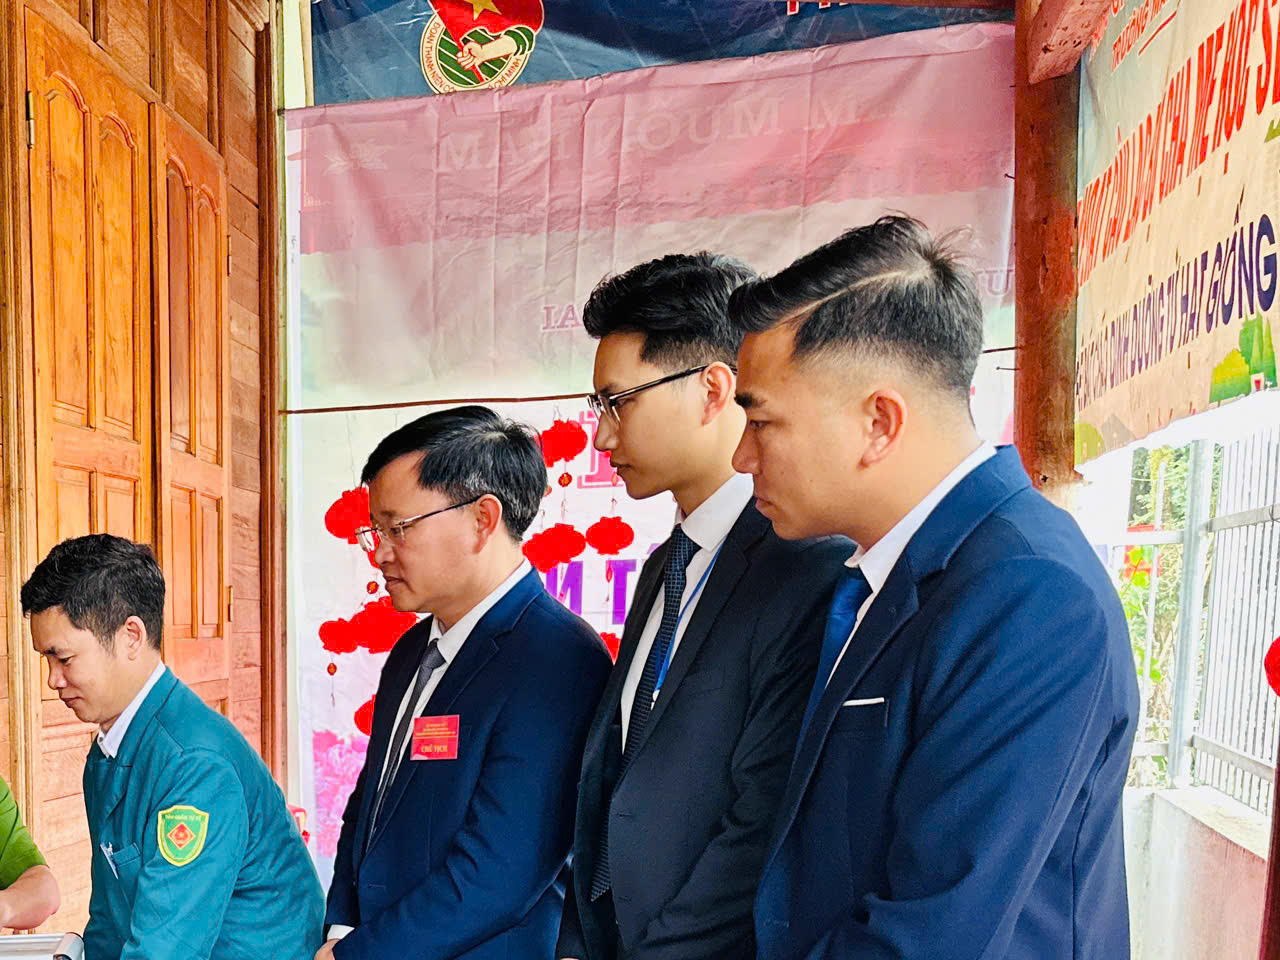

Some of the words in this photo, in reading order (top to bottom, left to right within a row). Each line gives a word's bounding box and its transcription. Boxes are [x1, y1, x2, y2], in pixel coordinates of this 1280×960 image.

[1159, 57, 1191, 205] CHA
[1187, 22, 1225, 196] MẸ
[1211, 0, 1260, 175] HỌC
[1178, 250, 1209, 369] HẠT
[1206, 184, 1278, 334] GIỐNG
